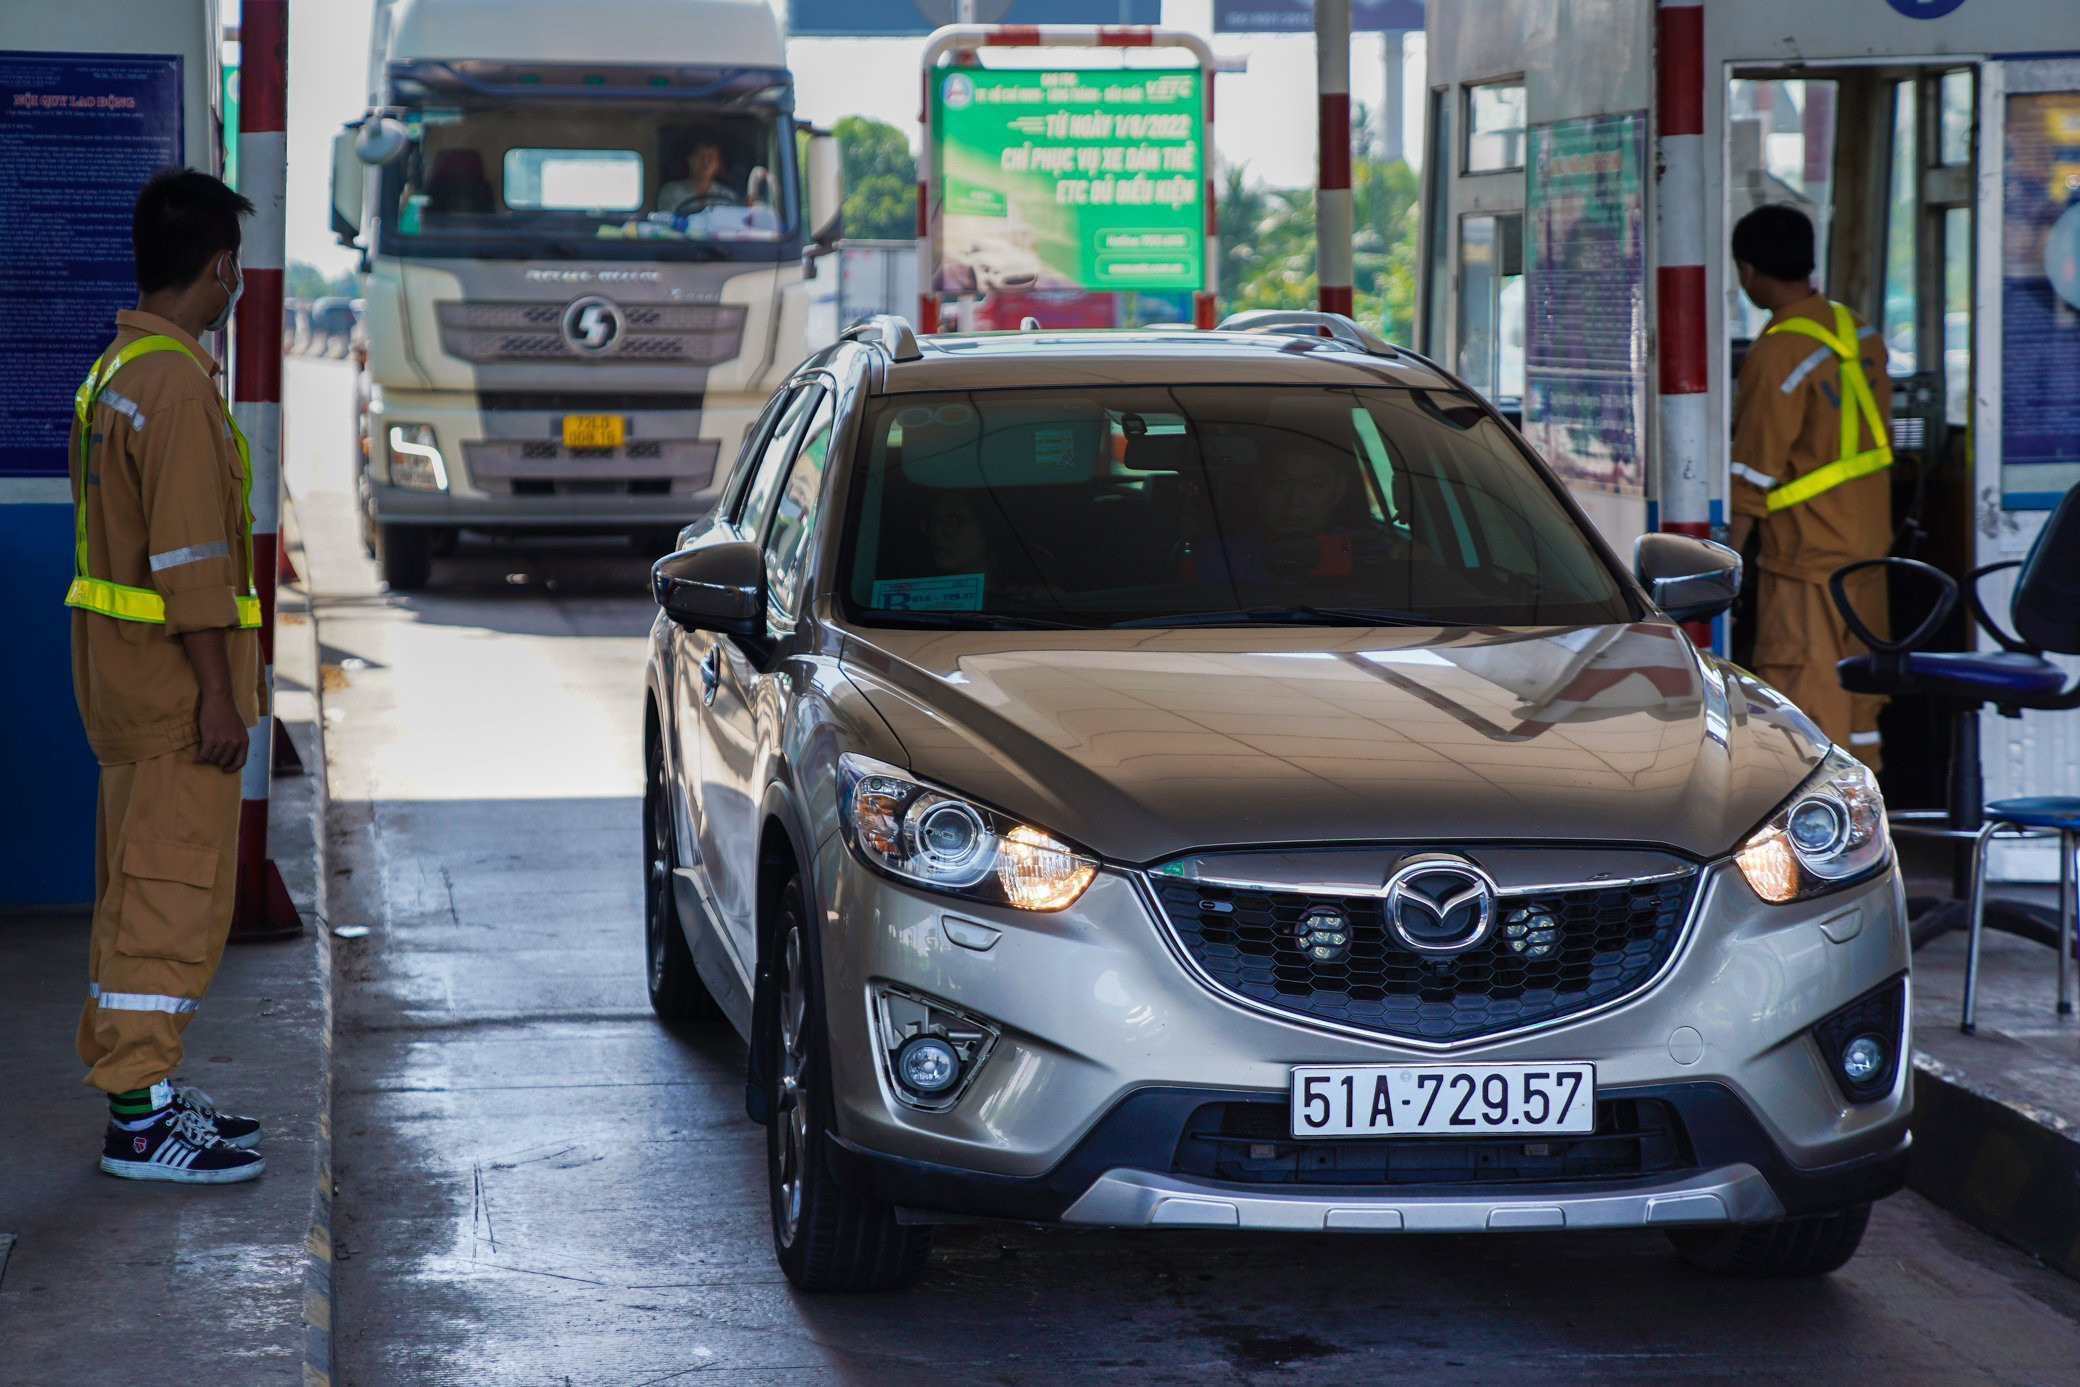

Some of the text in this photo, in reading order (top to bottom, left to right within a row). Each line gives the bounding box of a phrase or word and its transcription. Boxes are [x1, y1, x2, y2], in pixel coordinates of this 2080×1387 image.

[13, 92, 136, 110] NỘI QUY LAO ĐỘNG
[1046, 109, 1069, 139] TỪ
[1069, 109, 1114, 139] NGÀY
[1001, 141, 1031, 172] CHỈ
[1031, 147, 1076, 177] PHỤC
[1077, 147, 1101, 177] VỤ
[1101, 147, 1125, 171] XE
[1056, 179, 1090, 204] ETC
[1155, 174, 1197, 210] KIỆN
[1303, 1071, 1584, 1129] 51A-729.57
